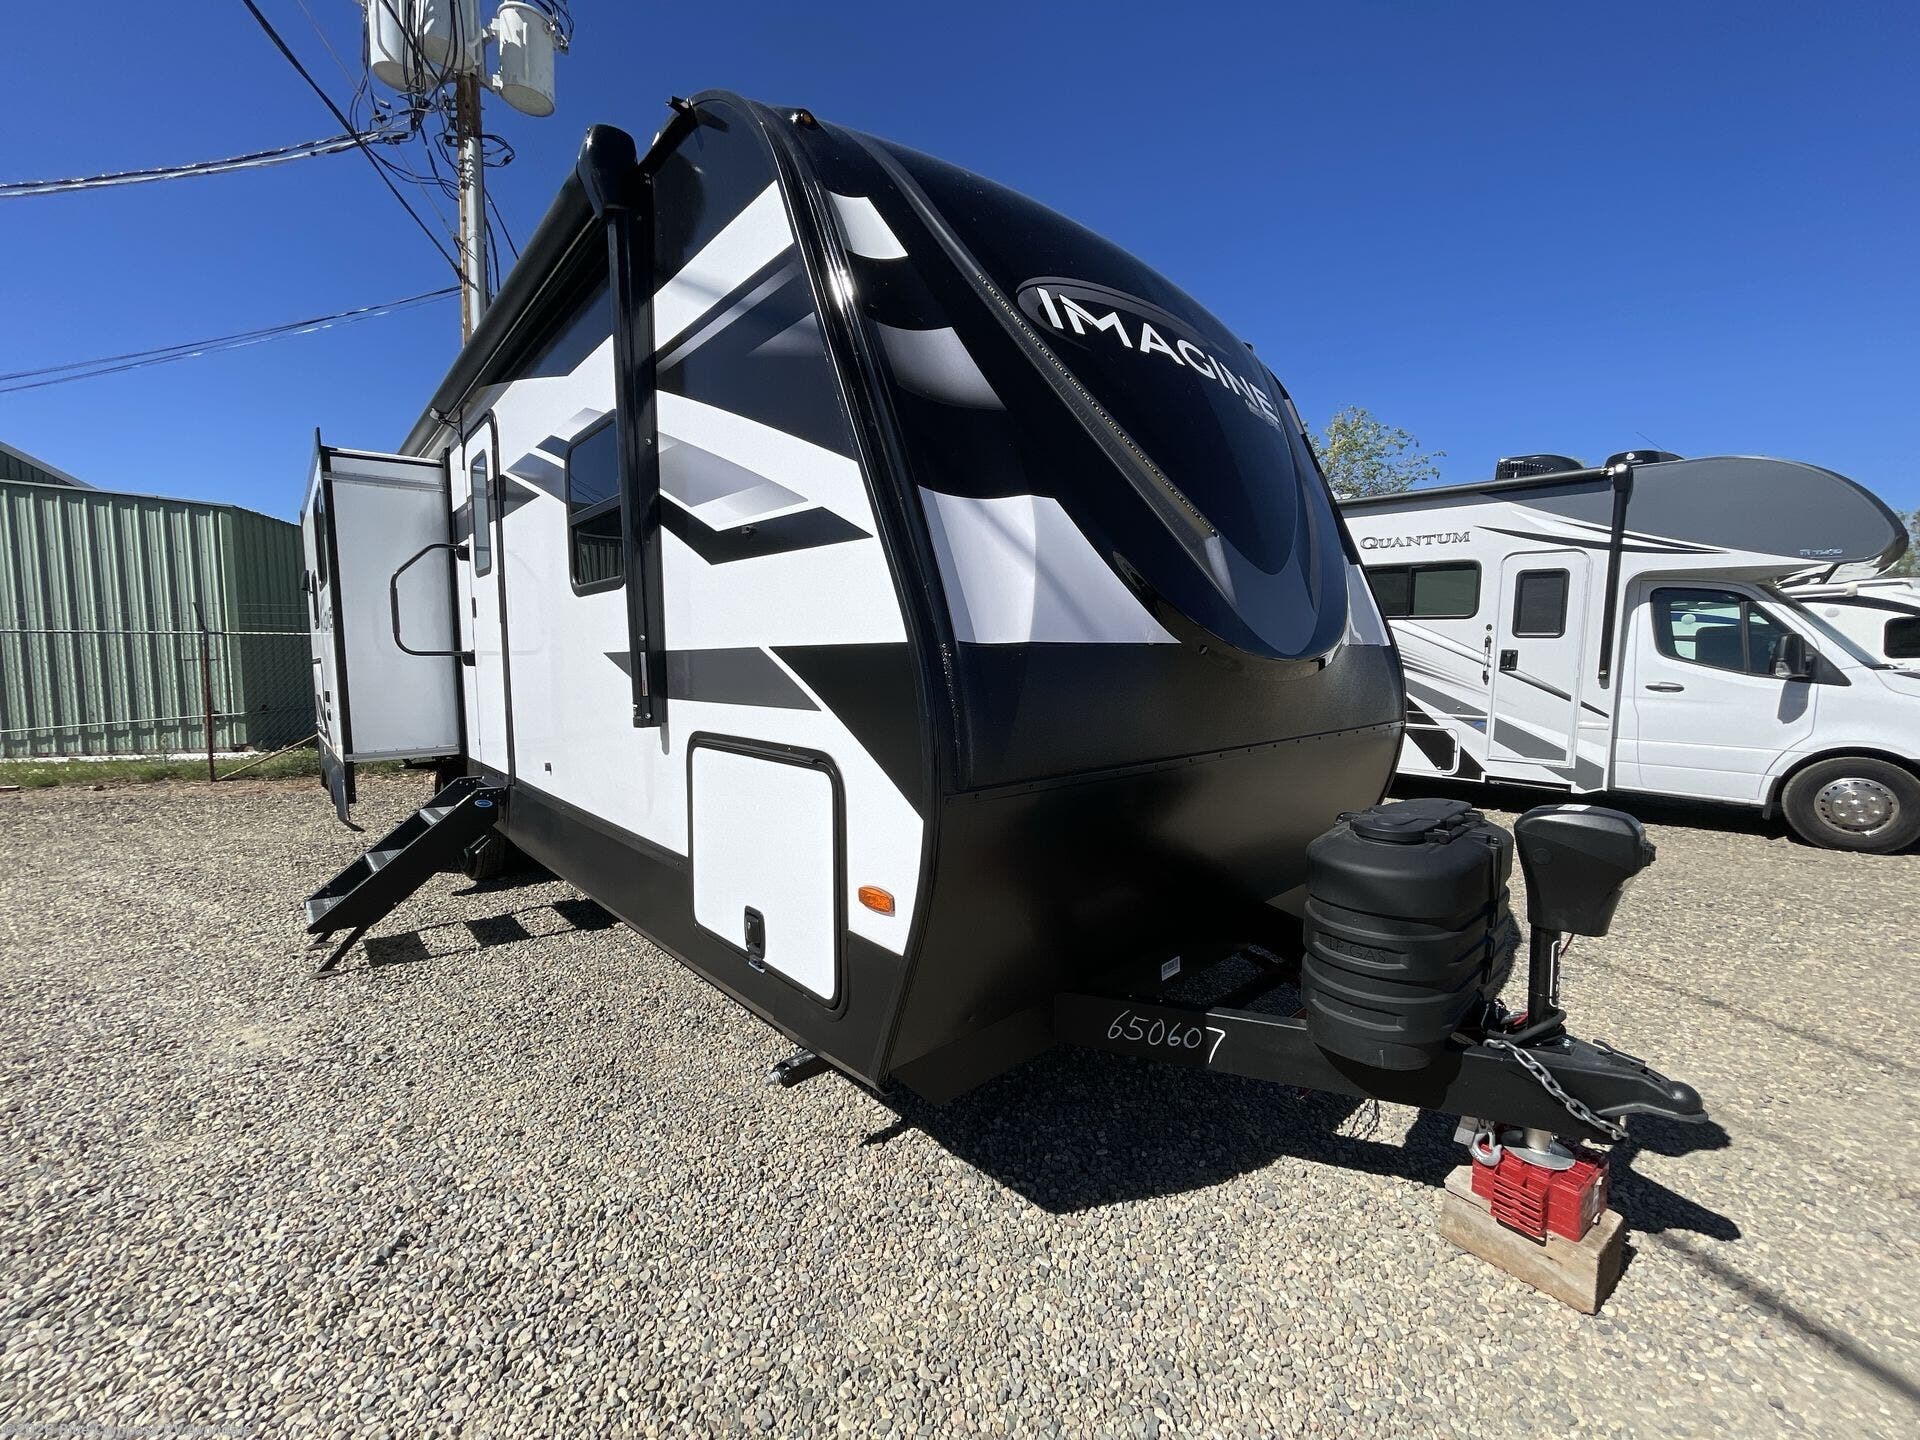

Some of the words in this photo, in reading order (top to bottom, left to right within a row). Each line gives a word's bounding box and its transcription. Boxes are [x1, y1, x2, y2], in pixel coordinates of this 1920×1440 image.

[1036, 286, 1280, 424] IMAGINE
[1360, 531, 1471, 550] QUANTUM
[1350, 945, 1386, 963] GAS
[1107, 1009, 1226, 1064] 650607
